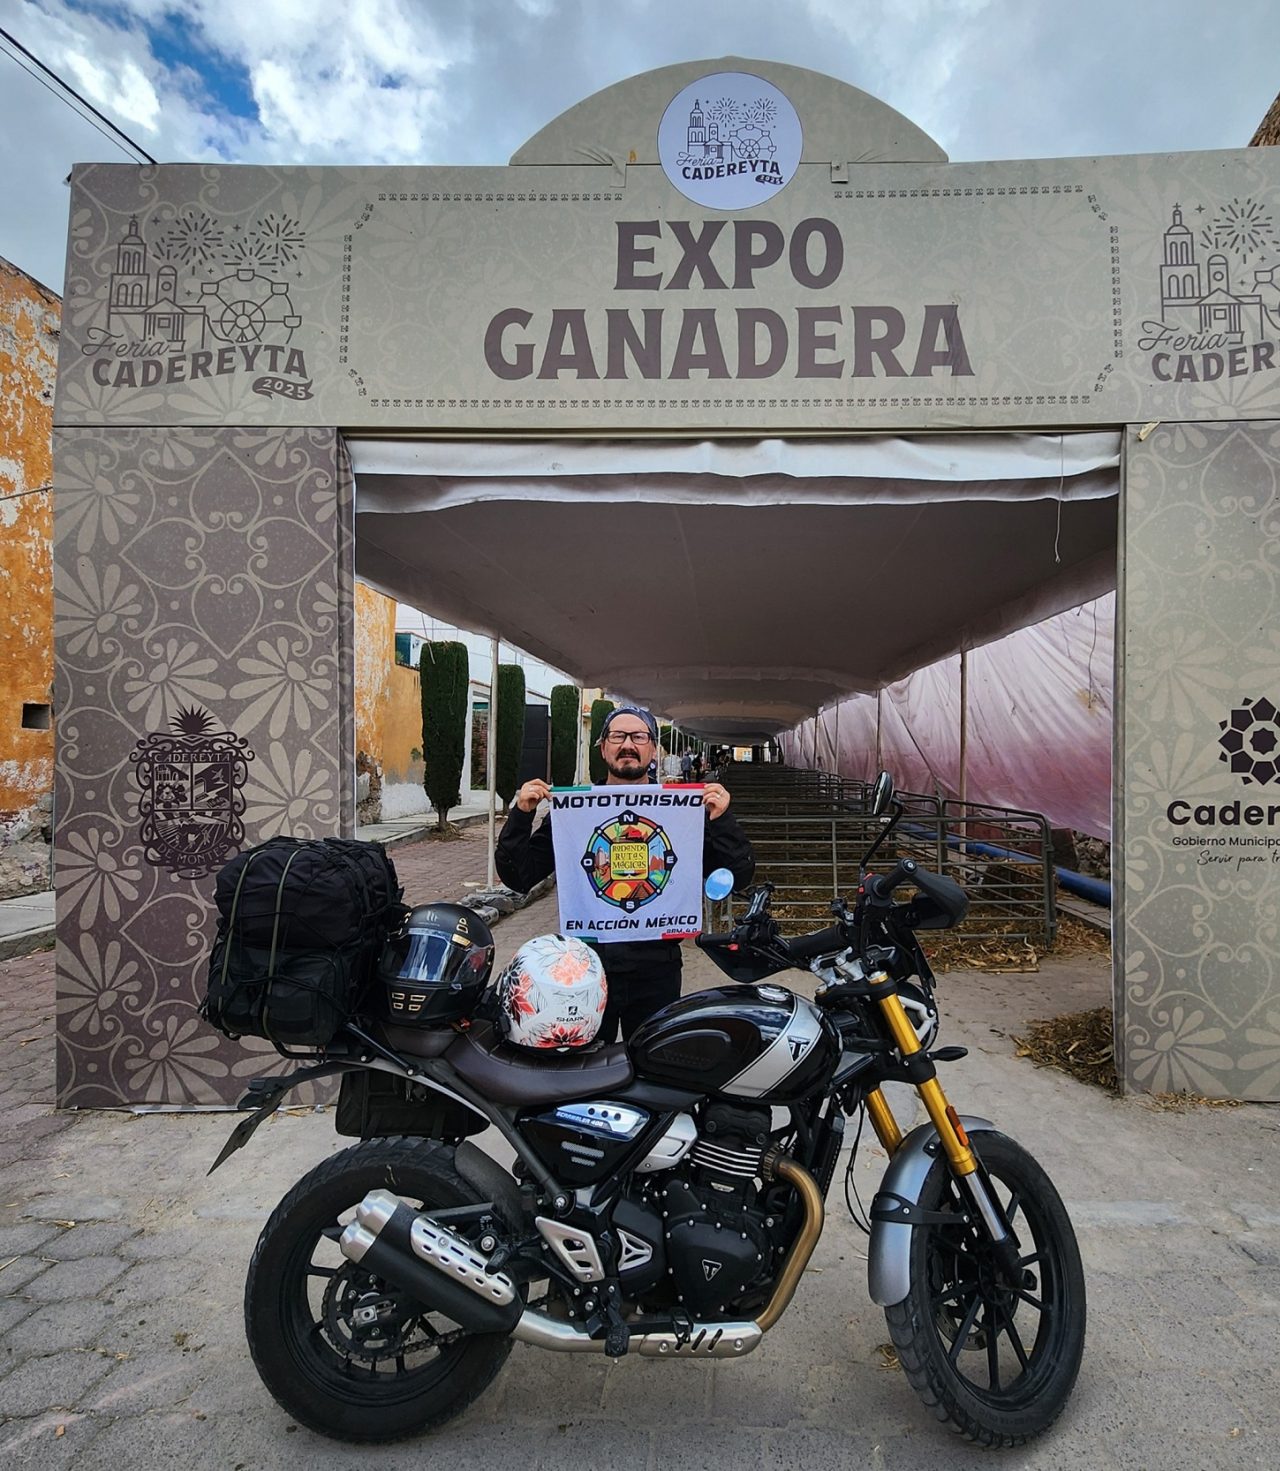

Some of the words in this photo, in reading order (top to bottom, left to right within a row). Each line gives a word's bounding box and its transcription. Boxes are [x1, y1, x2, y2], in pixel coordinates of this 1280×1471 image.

[676, 152, 716, 166] Feria
[682, 159, 781, 181] CADEREYTA
[613, 217, 844, 290] EXPO
[81, 327, 168, 358] Feria
[483, 304, 976, 380] GANADERA
[1138, 320, 1229, 351] Feria
[92, 344, 308, 388] CADEREYTA
[262, 378, 307, 398] 2025
[154, 752, 230, 763] CADEREYTA
[553, 794, 704, 809] MOTOTURISMO
[623, 814, 634, 822] N
[1172, 836, 1226, 847] Gobierno
[157, 844, 173, 858] DE
[177, 843, 229, 864] MONTES
[584, 858, 593, 866] O
[666, 856, 674, 864] E
[1197, 850, 1233, 866] Servir
[1238, 855, 1266, 871] para
[626, 901, 635, 909] S
[566, 920, 583, 930] EN
[588, 916, 639, 930] ACCIÓN
[645, 913, 698, 928] MÉXICO
